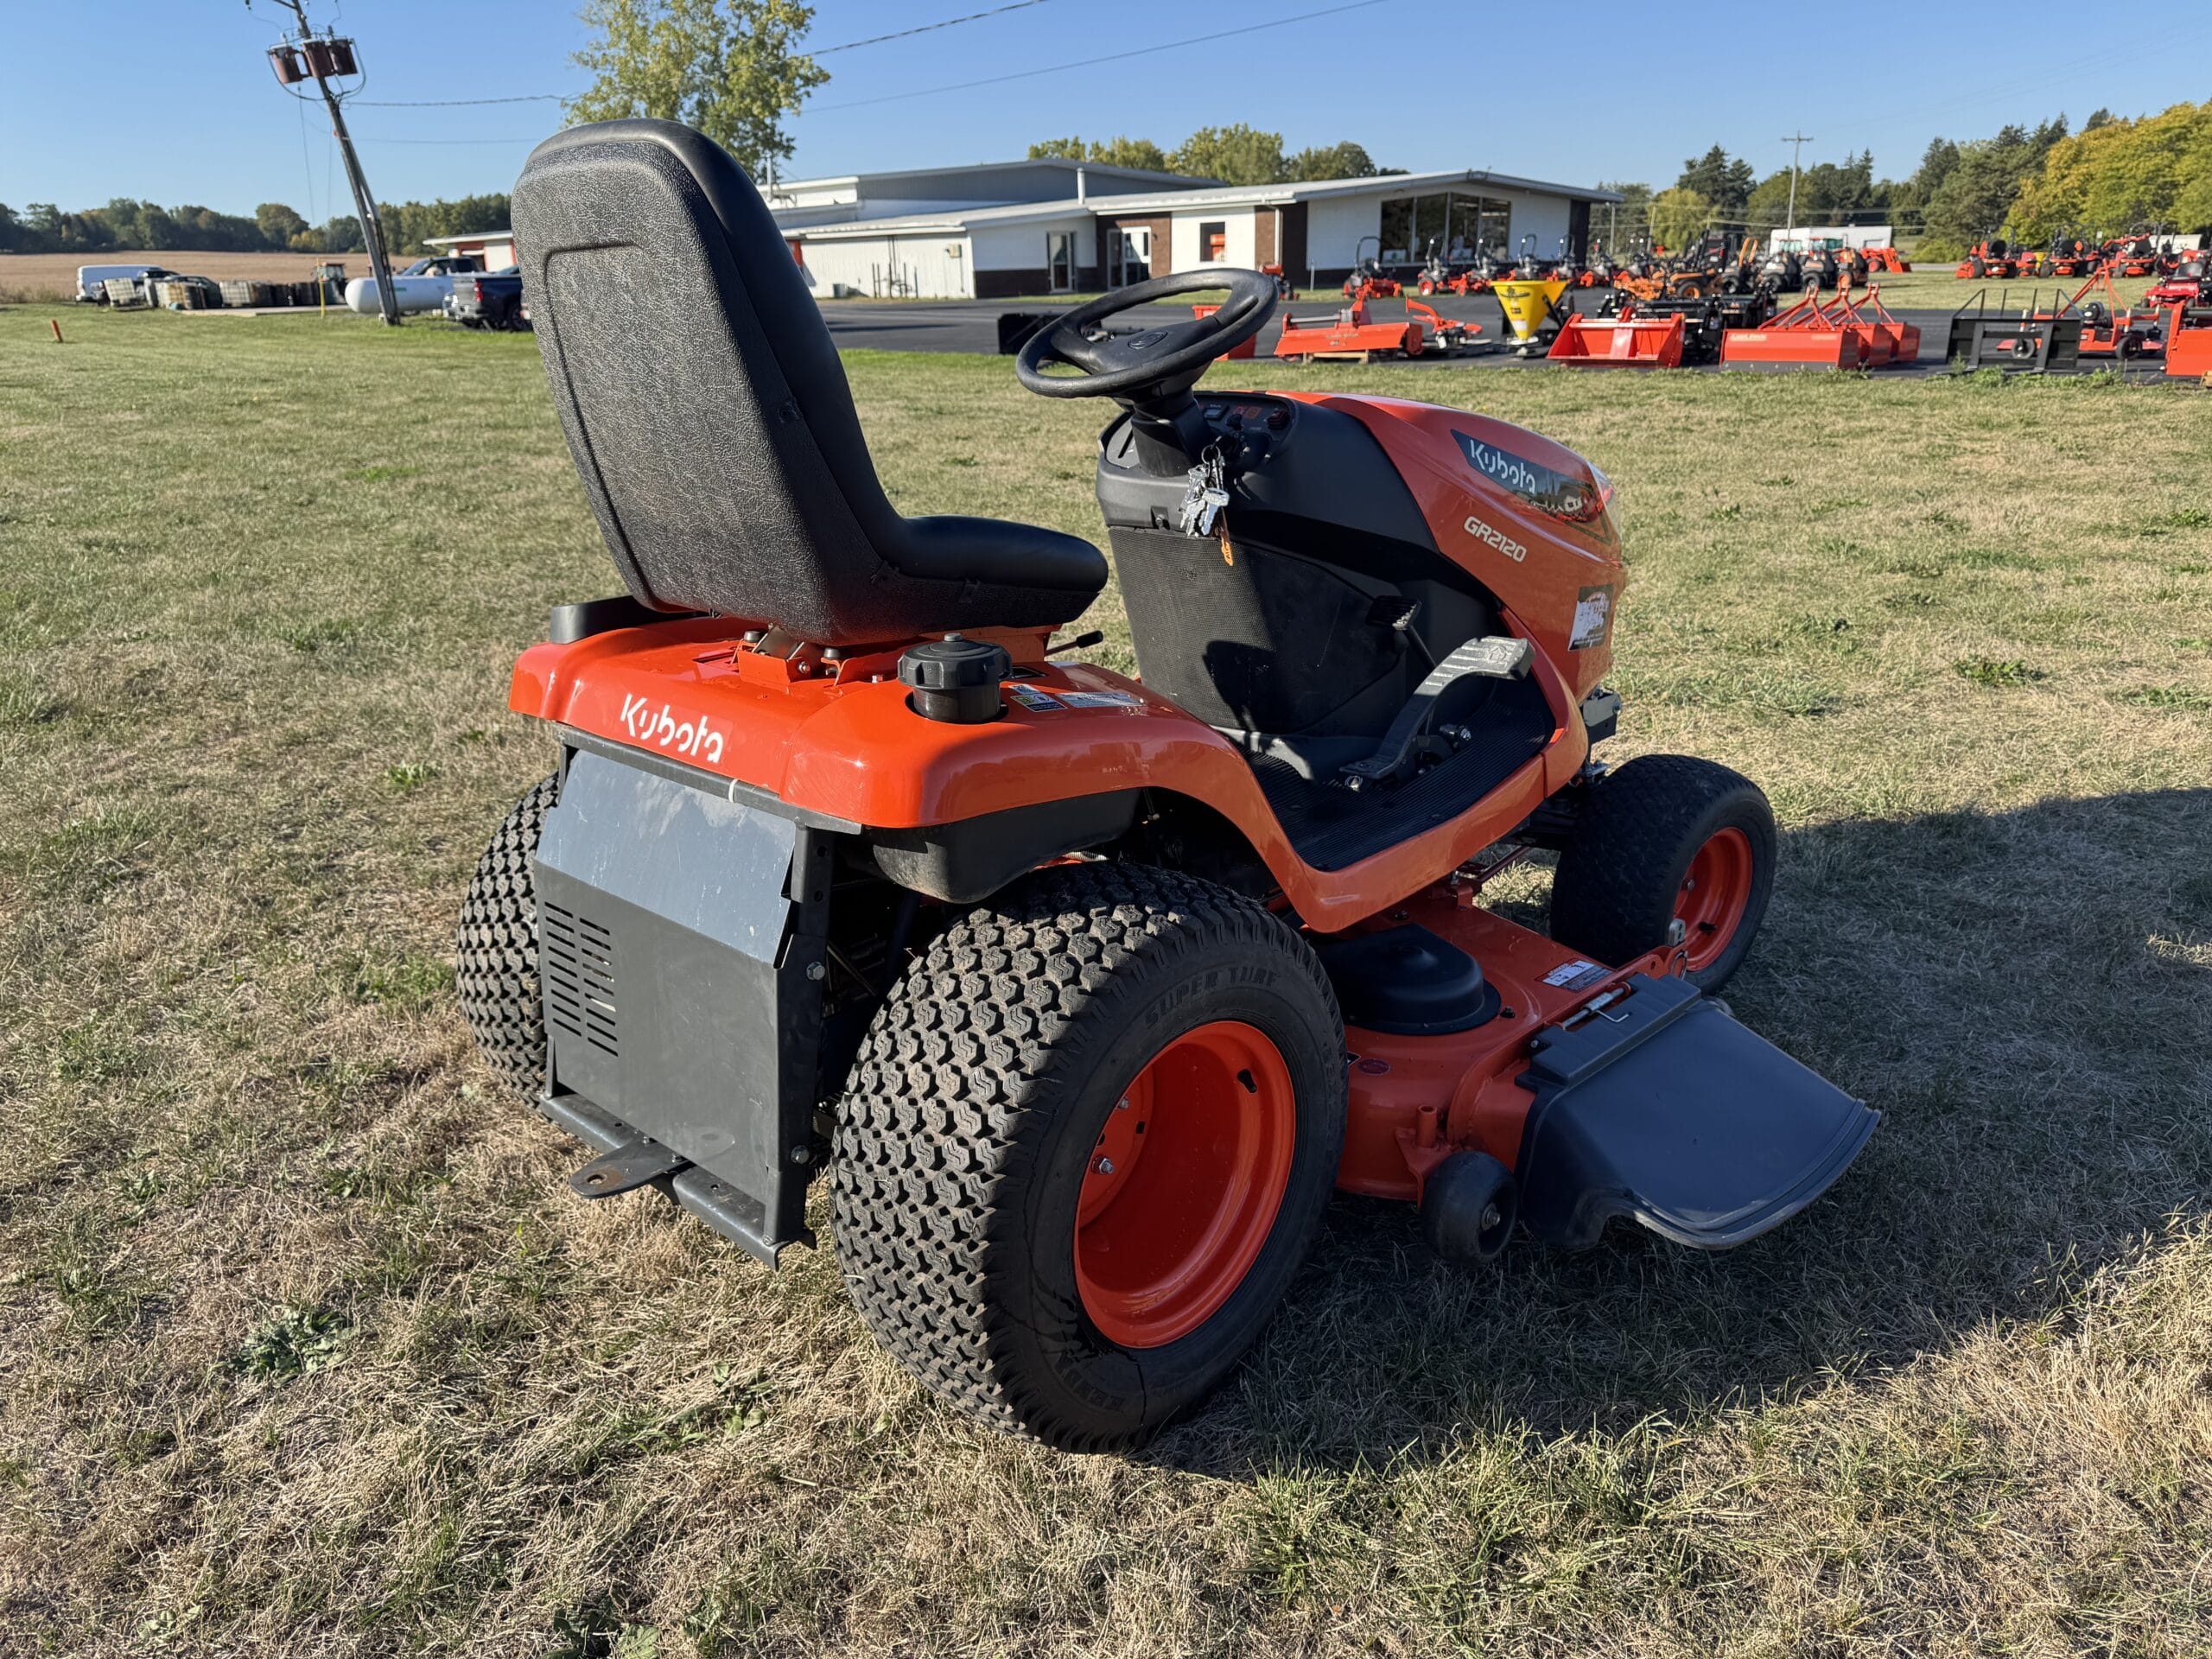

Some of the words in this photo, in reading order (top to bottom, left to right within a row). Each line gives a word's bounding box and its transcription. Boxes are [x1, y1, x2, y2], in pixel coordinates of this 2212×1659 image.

[1470, 440, 1536, 494] Kubota
[1464, 516, 1528, 563] GR2120
[620, 693, 724, 764] Kubota
[1146, 972, 1219, 1025] SUPER
[1229, 966, 1278, 987] TURF
